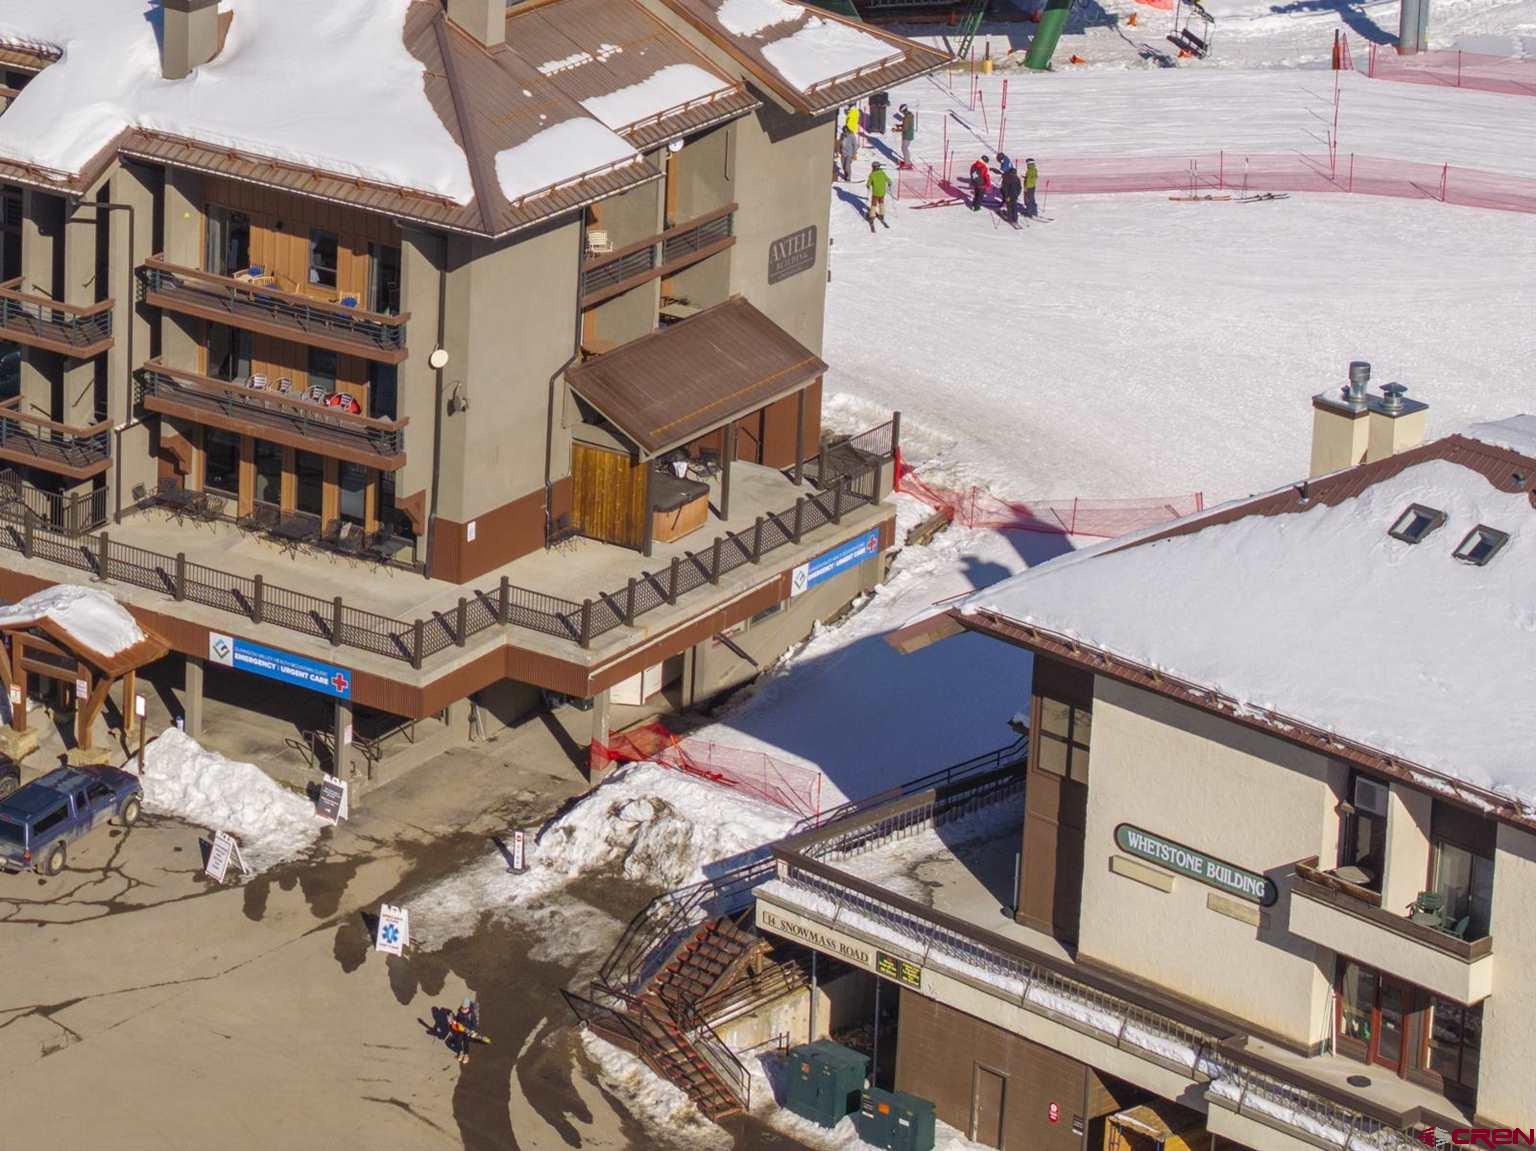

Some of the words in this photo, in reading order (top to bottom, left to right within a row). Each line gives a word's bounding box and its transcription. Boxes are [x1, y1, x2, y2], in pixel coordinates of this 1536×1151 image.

[234, 653, 276, 671] EMERGENCY
[280, 664, 309, 680] URGENT
[310, 674, 329, 686] CARE
[1127, 830, 1203, 874] WHETSTONE
[1206, 861, 1265, 897] BUILDING
[780, 919, 837, 950] SNOWMASS
[839, 943, 869, 962] ROAD
